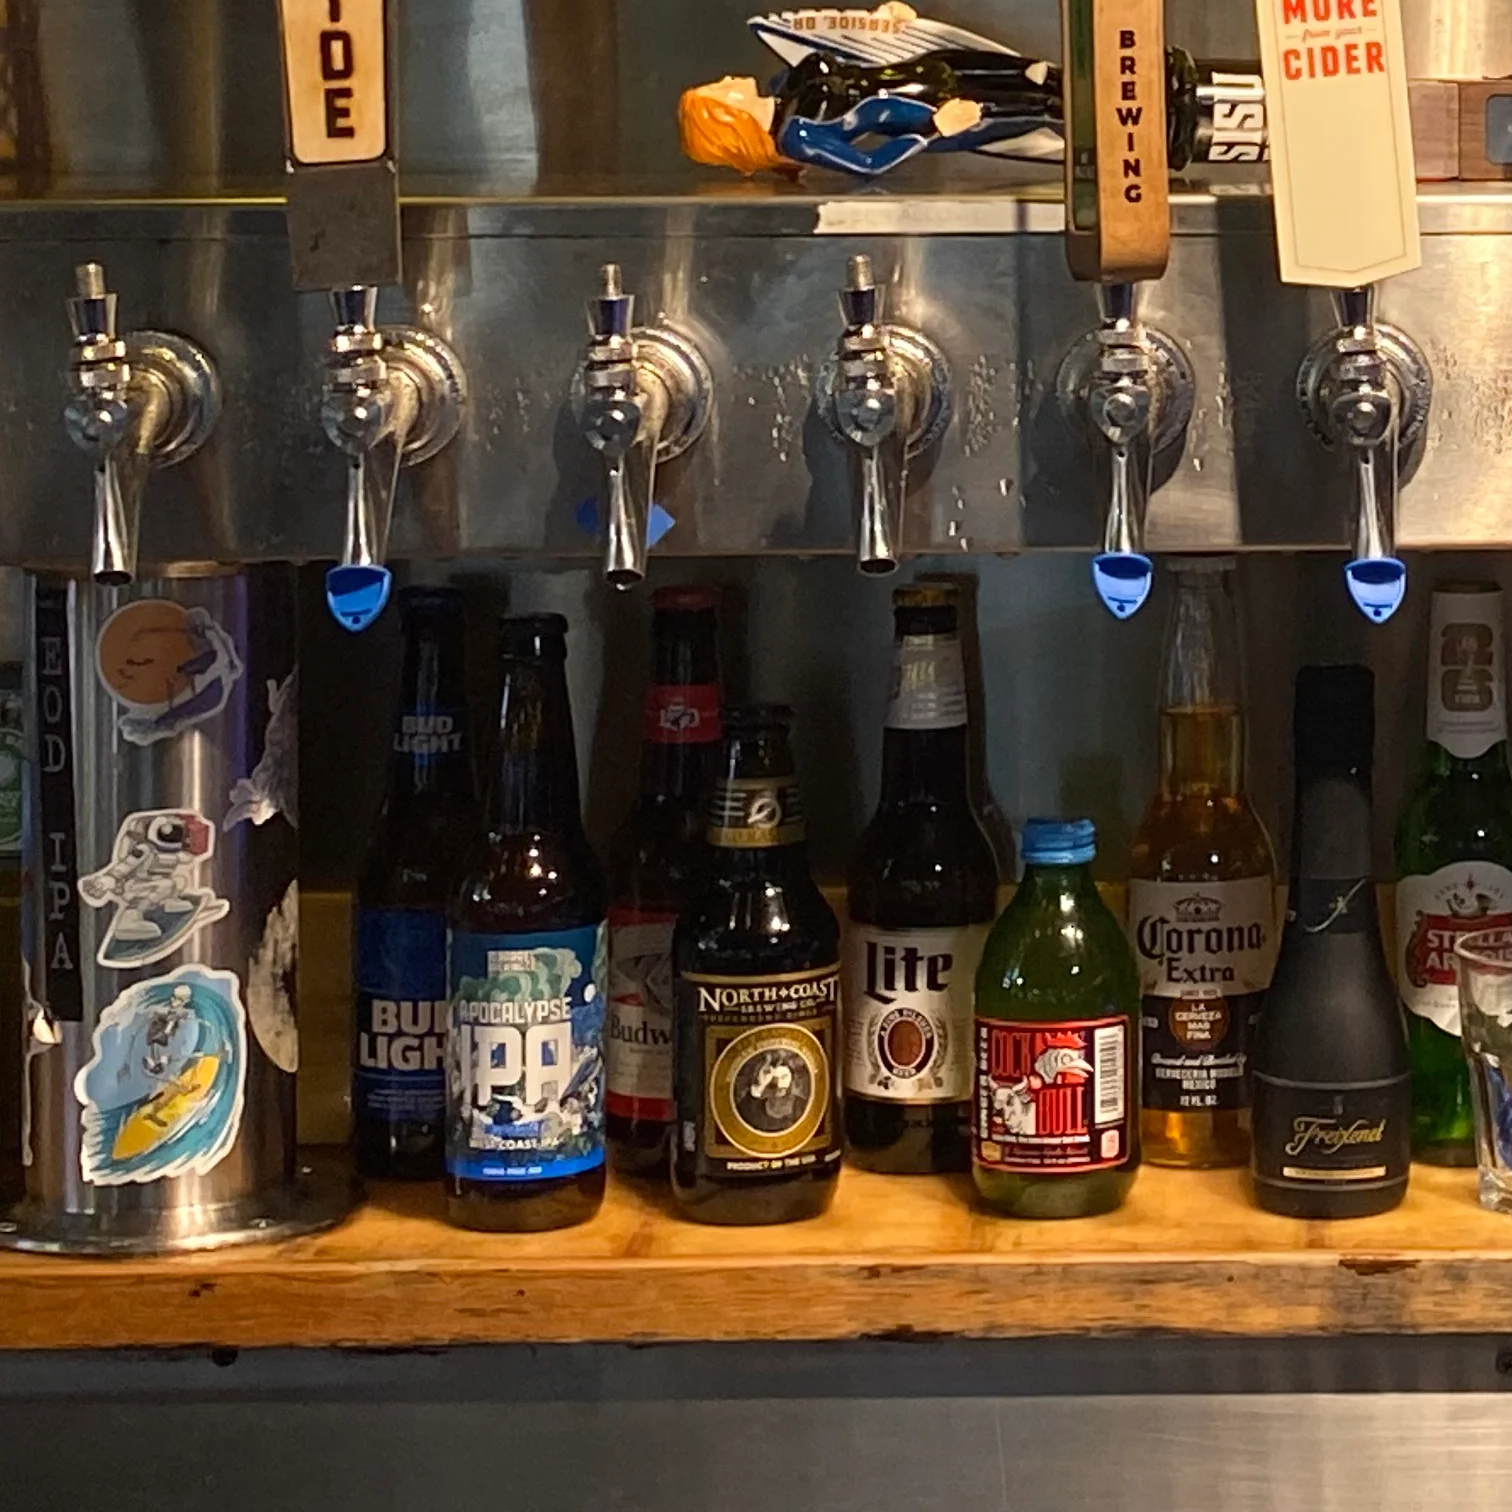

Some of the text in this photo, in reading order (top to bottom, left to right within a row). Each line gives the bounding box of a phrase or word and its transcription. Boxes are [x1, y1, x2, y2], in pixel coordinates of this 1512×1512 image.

[1283, 41, 1385, 81] CIDER
[1116, 29, 1143, 204] BREWING
[393, 731, 462, 754] LIGHT
[401, 715, 453, 734] BUD
[47, 831, 74, 970] IPA
[1137, 914, 1262, 966] Corona
[864, 940, 953, 1005] Lite
[1166, 956, 1236, 985] Extra
[459, 997, 572, 1025] APOCALYPSE
[697, 975, 838, 1012] NORTH COAST
